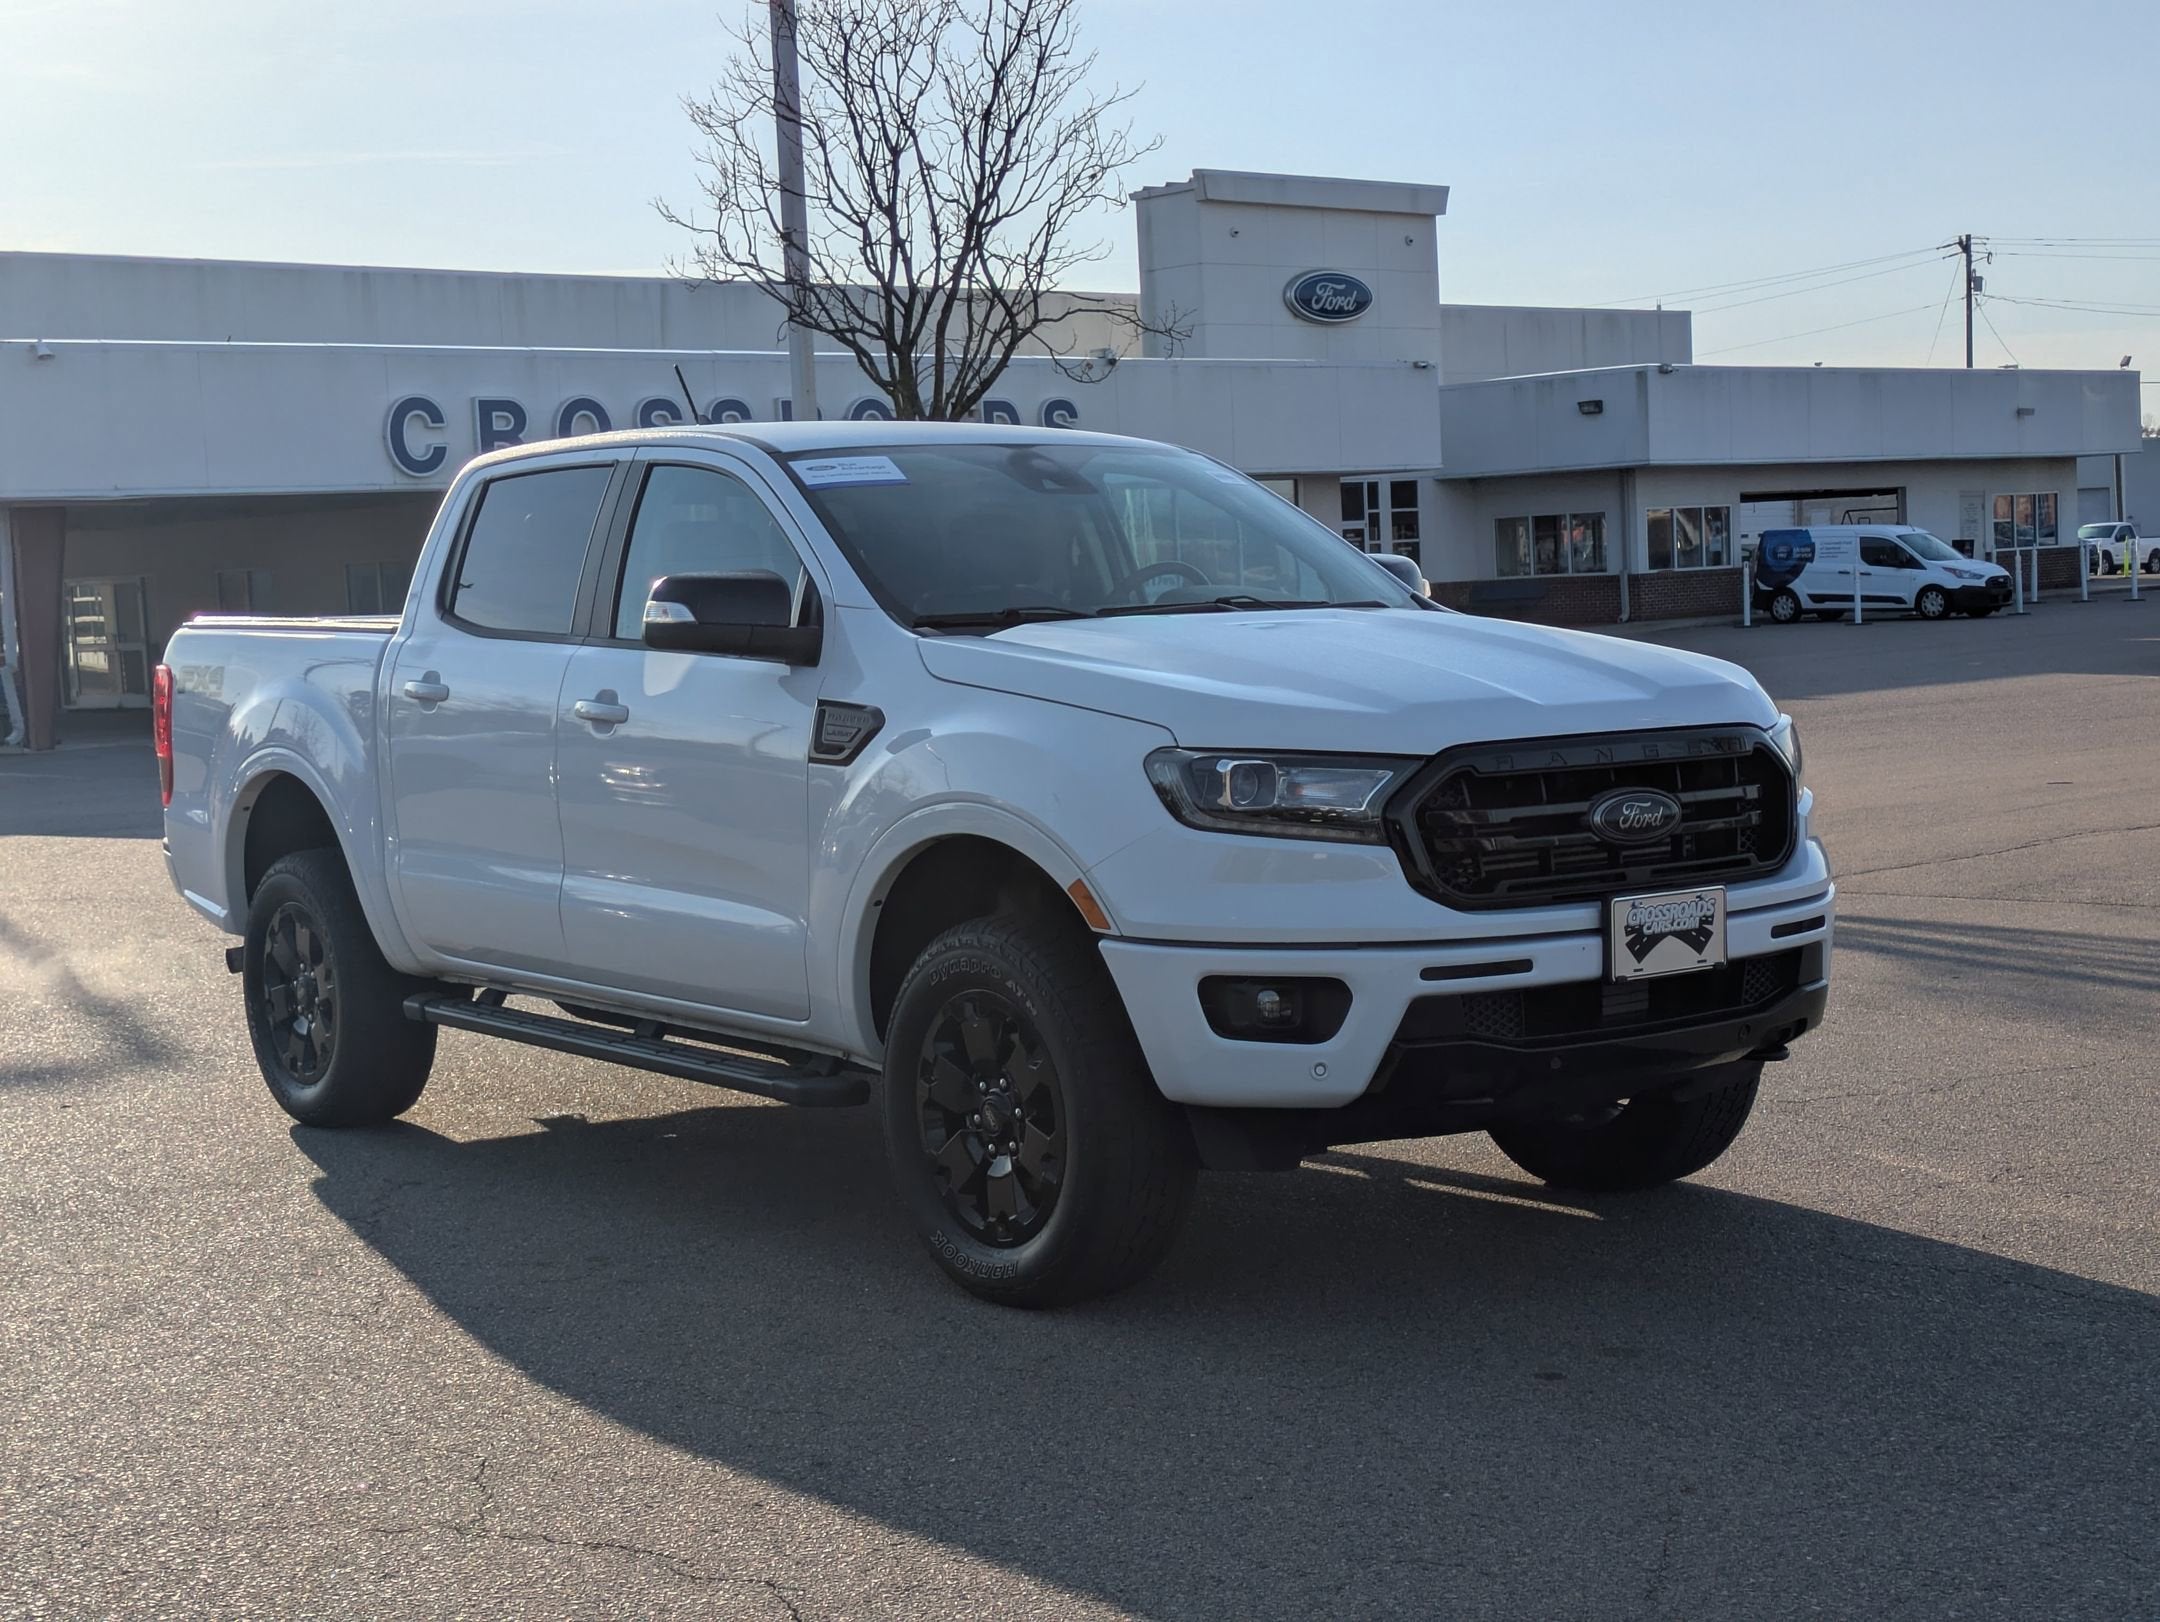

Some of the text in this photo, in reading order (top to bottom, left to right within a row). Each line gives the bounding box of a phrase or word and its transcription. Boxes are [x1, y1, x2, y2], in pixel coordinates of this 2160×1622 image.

[1311, 282, 1357, 311] Ford
[177, 665, 225, 692] FX4
[1619, 801, 1664, 830] Ford
[1626, 898, 1716, 926] CROSSROADS
[1643, 917, 1700, 935] CARS.COM
[928, 957, 1002, 987] Dynapro
